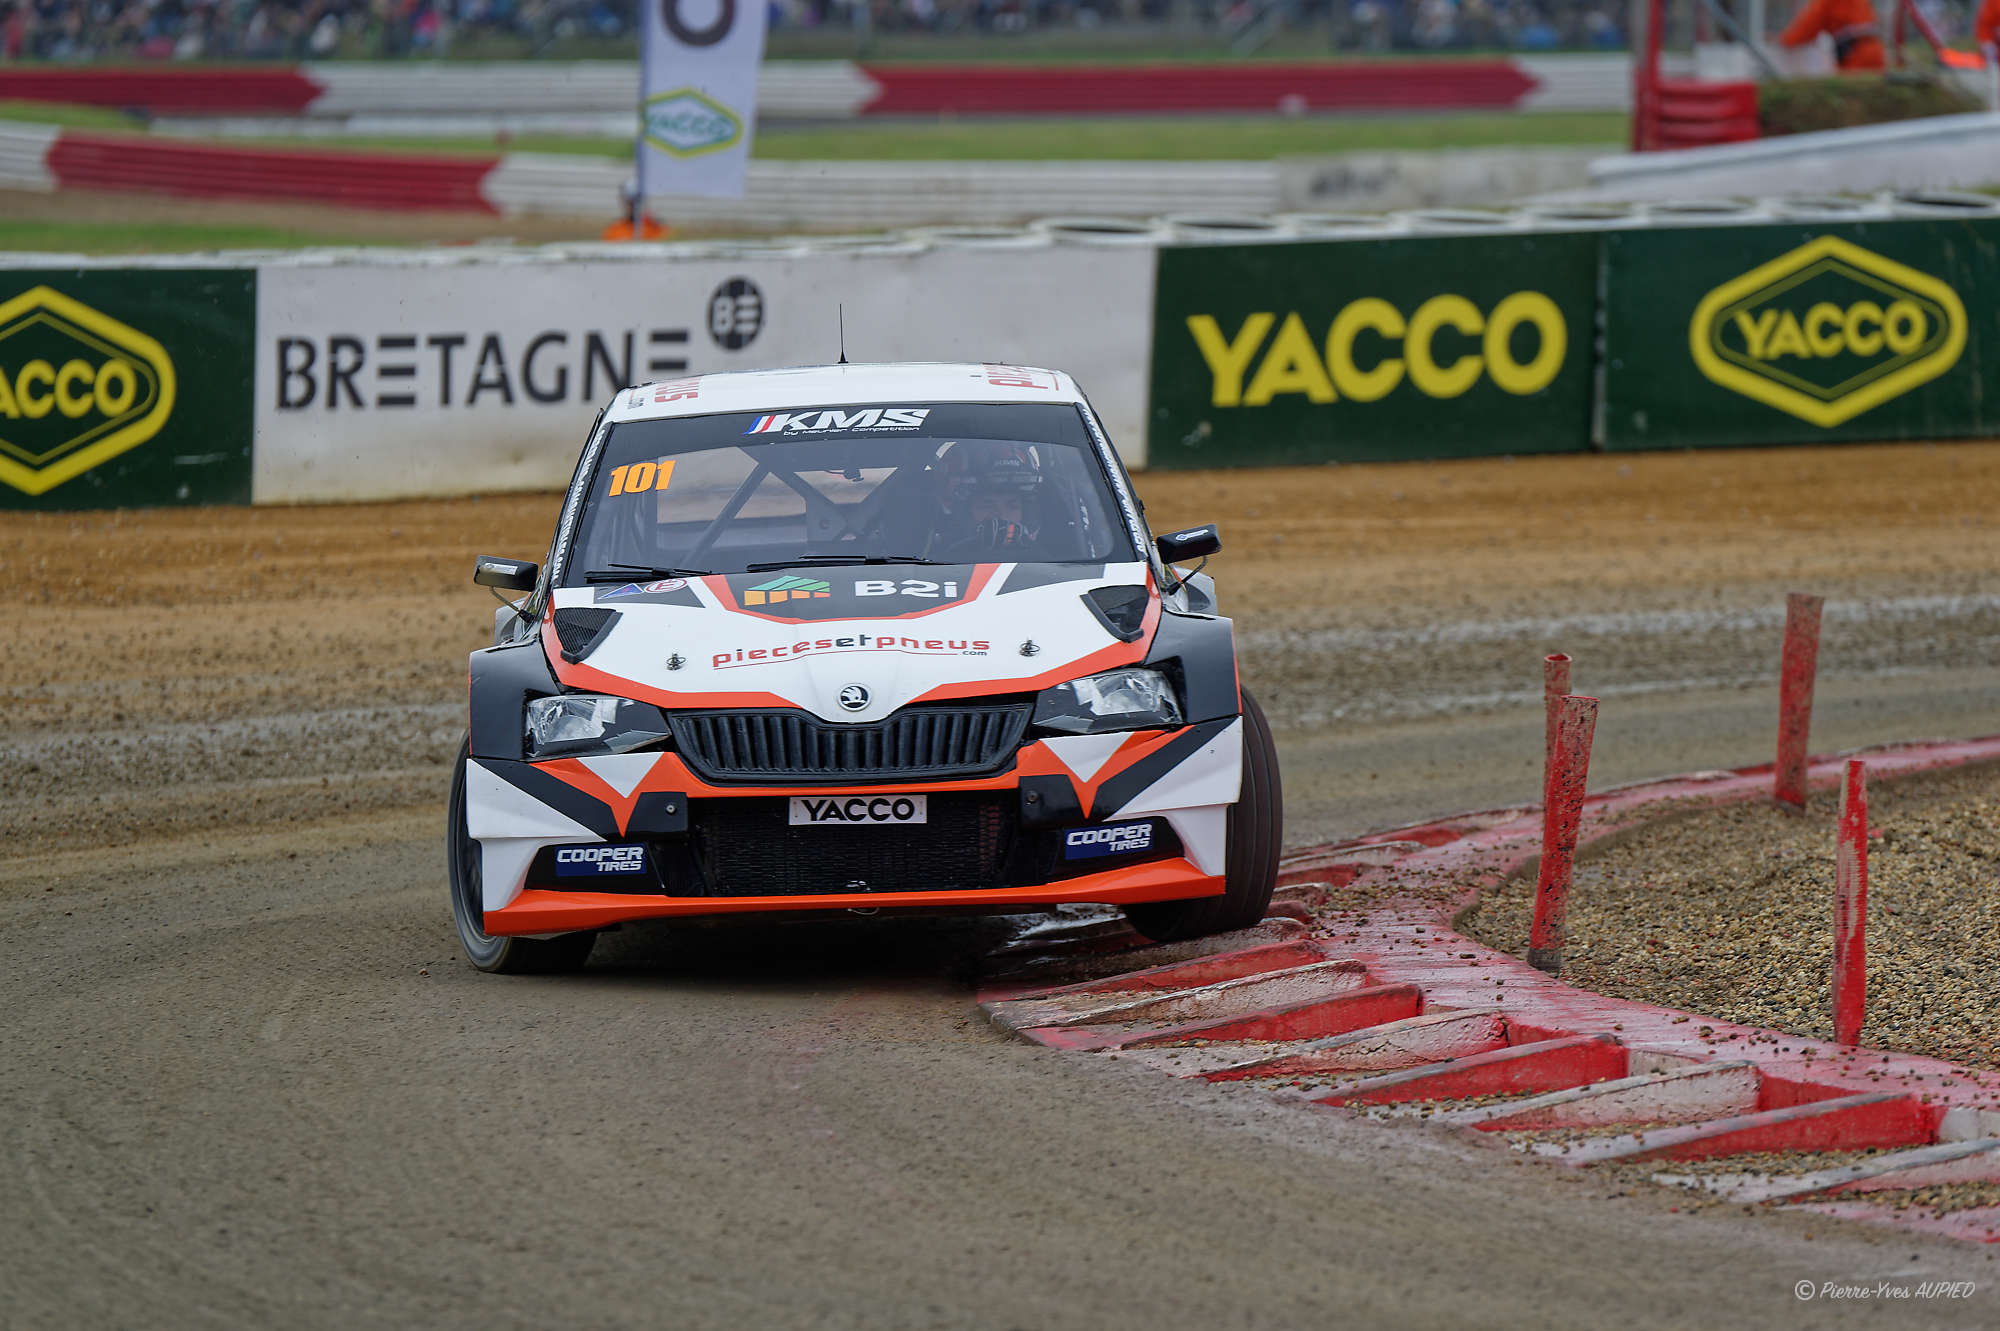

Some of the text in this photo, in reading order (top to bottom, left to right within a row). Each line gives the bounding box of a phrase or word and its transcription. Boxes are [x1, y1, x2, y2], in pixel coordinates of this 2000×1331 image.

[1732, 300, 1926, 360] YACCO
[1186, 290, 1568, 408] YACCO
[278, 330, 690, 410] BRETAGNE
[767, 409, 931, 433] KMS
[608, 459, 676, 497] 101
[855, 580, 958, 598] B2i
[711, 634, 991, 668] piecesetpneus
[802, 797, 915, 822] YACCO
[1066, 823, 1153, 846] COOPER
[1109, 837, 1151, 851] TIRES
[557, 846, 644, 862] COOPER
[596, 860, 642, 872] TIRES
